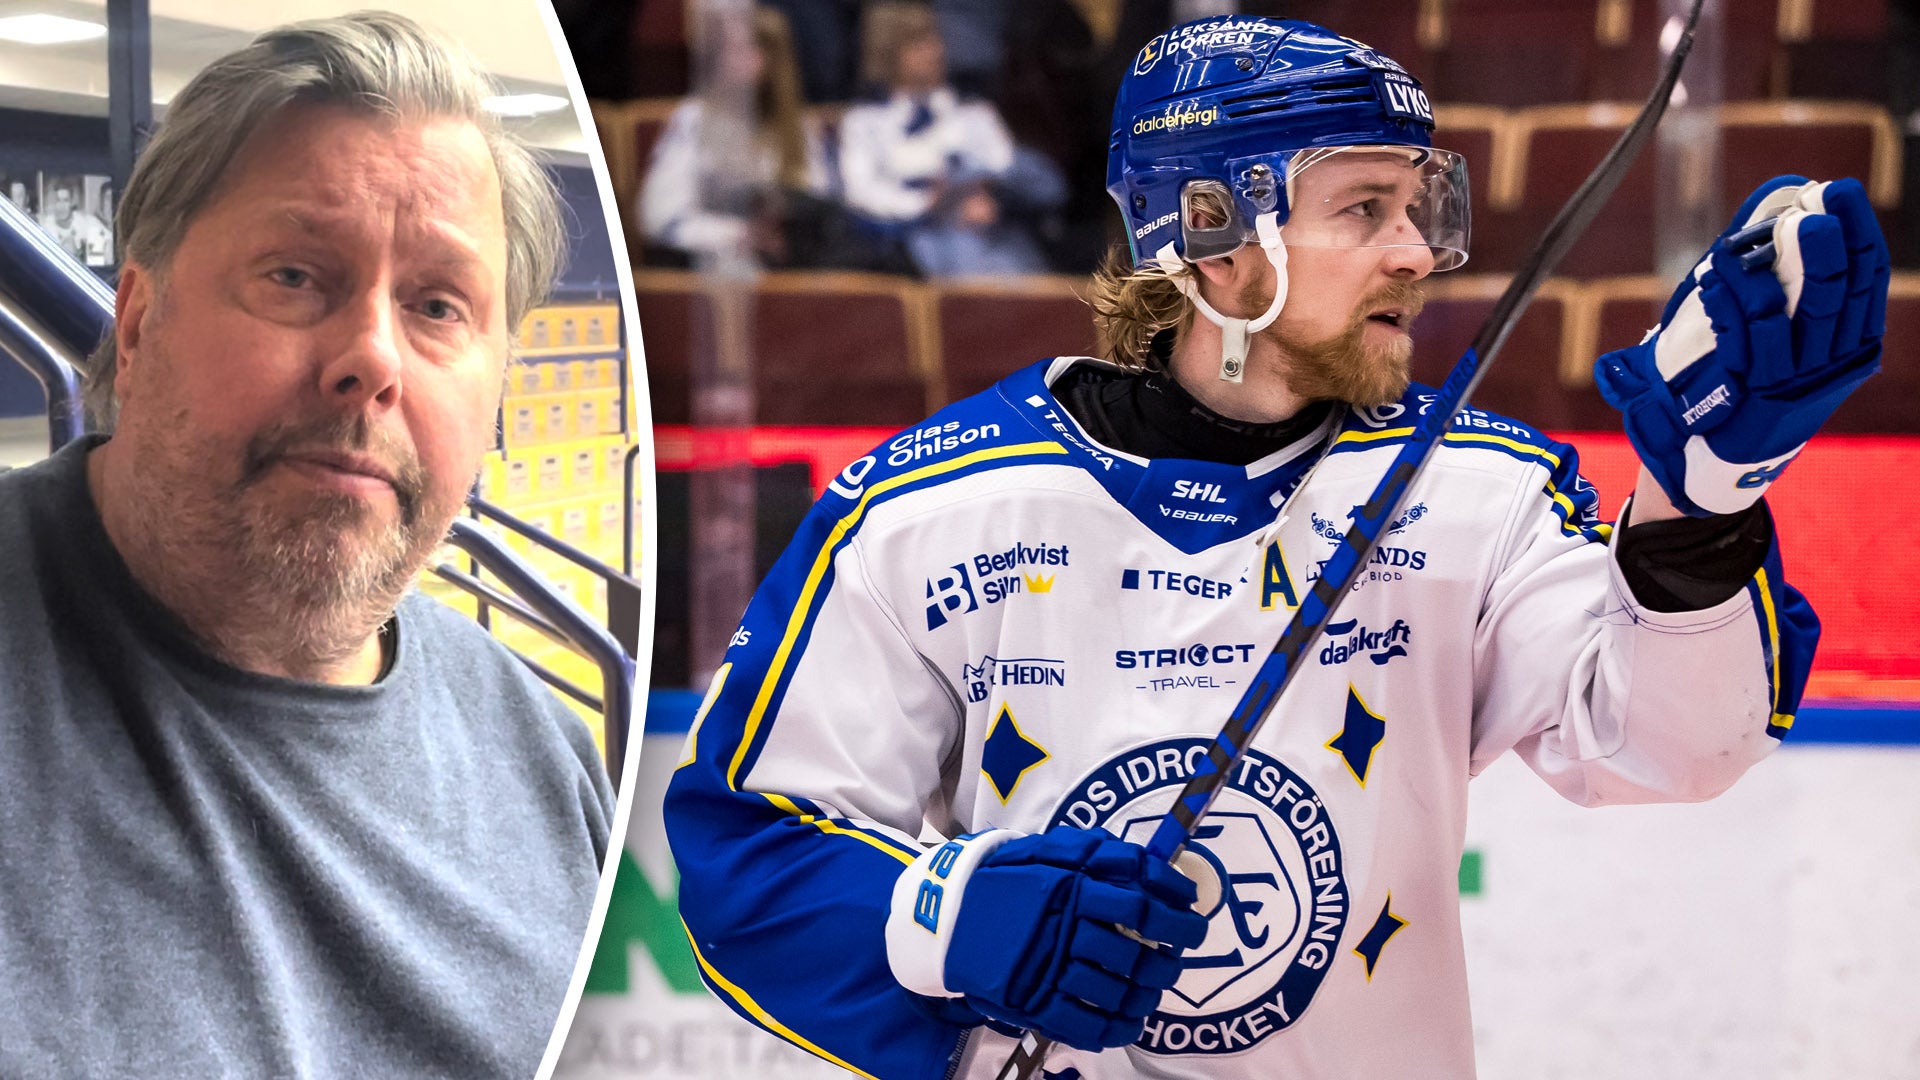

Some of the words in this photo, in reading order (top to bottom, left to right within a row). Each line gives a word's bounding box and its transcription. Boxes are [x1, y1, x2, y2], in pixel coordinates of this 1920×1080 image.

[1170, 20, 1284, 41] LEKSANDS
[1385, 82, 1433, 120] LYKO
[1133, 106, 1217, 135] dalaenergi
[1135, 211, 1179, 240] BAUER
[887, 423, 1001, 467] Ohlson
[889, 420, 960, 452] Clas
[1171, 479, 1227, 503] SHL
[1171, 509, 1238, 525] BAUER
[1148, 570, 1248, 600] TEGER
[1259, 537, 1301, 611] A
[1001, 664, 1065, 687] HEDIN
[1149, 676, 1220, 692] TRAVEL
[1115, 745, 1343, 970] IDROTSFÖRENING
[1137, 990, 1291, 1050] HOCKEY
